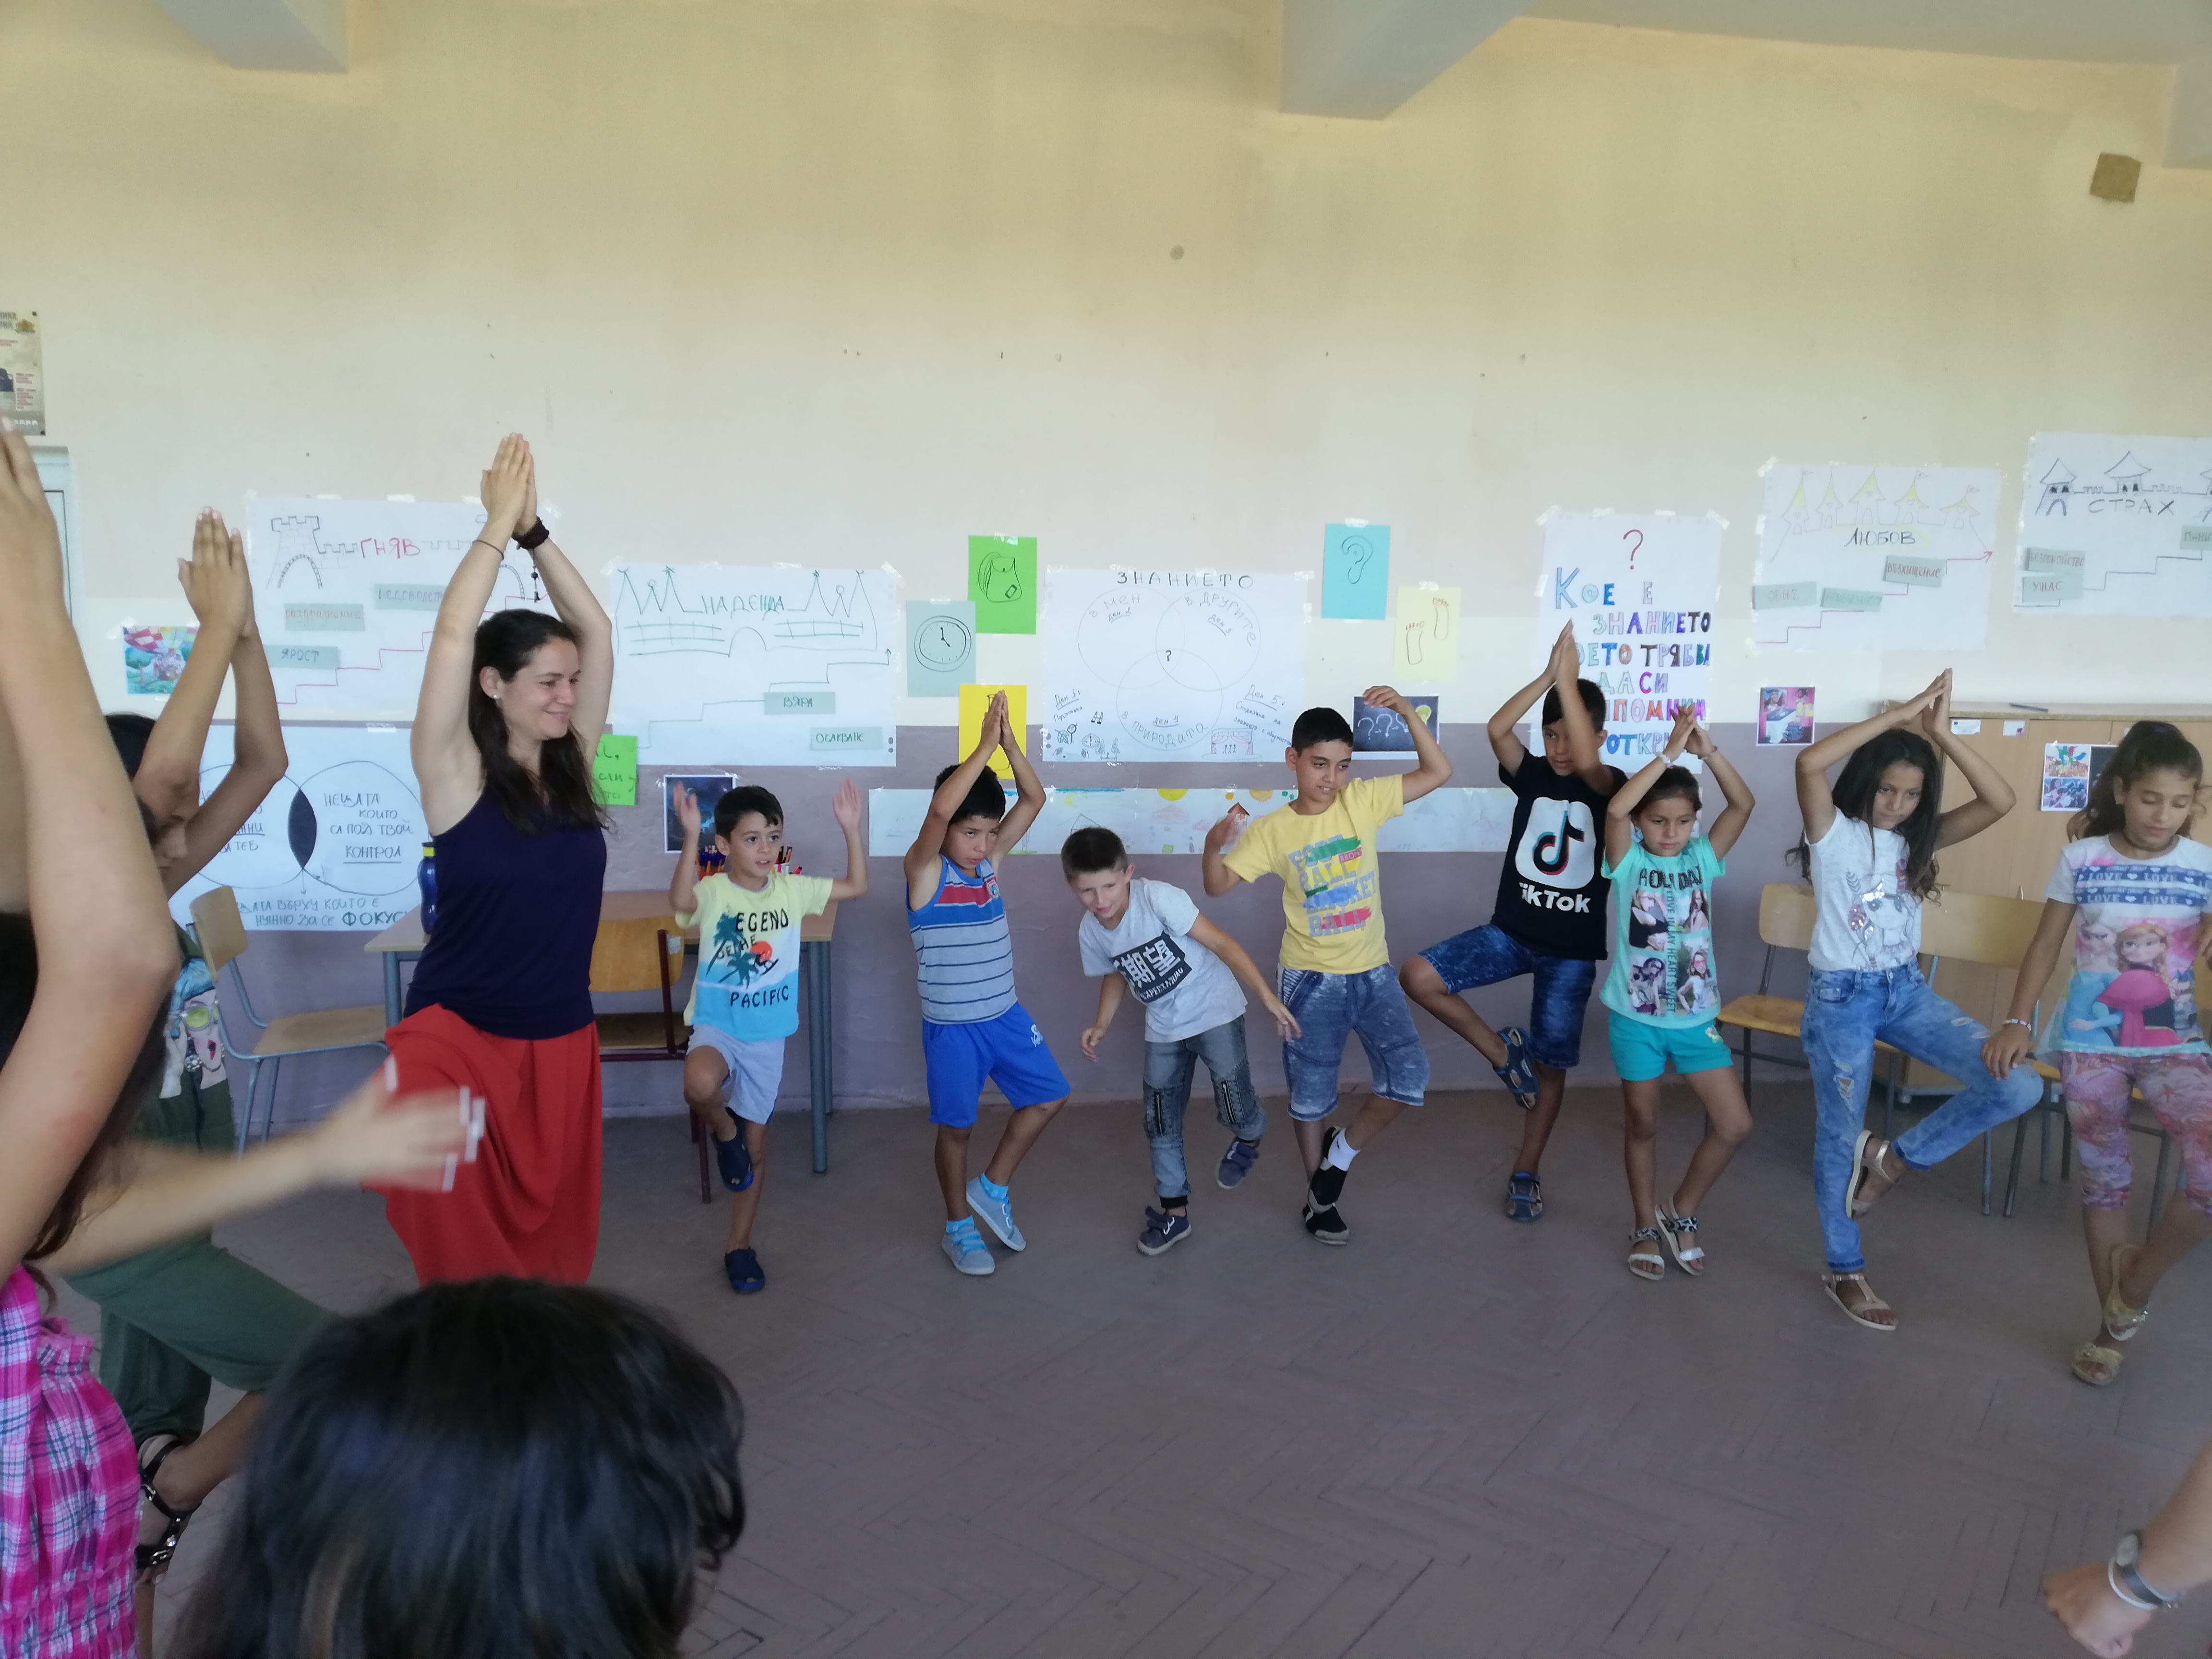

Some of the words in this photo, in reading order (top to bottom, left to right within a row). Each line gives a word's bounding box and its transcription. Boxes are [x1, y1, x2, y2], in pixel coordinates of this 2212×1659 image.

[2087, 499, 2175, 516] СТРАХ
[1844, 527, 1916, 547] ЛЮБОВ
[359, 537, 421, 559] ГНЯВ
[1117, 571, 1254, 589] ЗНАНИЕТО
[2032, 581, 2064, 593] УЖАС
[701, 594, 786, 621] НАДЕЖДА
[1592, 612, 1712, 635] ЗНАНИЕТО
[281, 648, 320, 663] ЯРОСТ
[1575, 642, 1633, 667] ОЕТО
[1640, 643, 1711, 667] ТРЯБВА
[1597, 671, 1635, 695] ДА
[1639, 672, 1669, 695] СИ
[783, 697, 814, 709] ВЯРА
[815, 732, 866, 744] ОЧАКВАНЕ
[325, 793, 380, 808] НЕЩАТА
[359, 809, 398, 819] КОИТО
[330, 824, 343, 834] СА
[347, 823, 373, 835] ПОД
[379, 817, 414, 835] ТВОЙ
[345, 845, 402, 859] КОНТРОЛ
[2088, 872, 2123, 882] LOVE
[325, 898, 367, 910] КОИТО
[2087, 894, 2121, 903] LOVE
[255, 914, 294, 927] НУЖНО
[342, 911, 409, 926] ФОКУС
[735, 907, 789, 932] EGEND
[1667, 948, 1676, 978] HEART
[730, 984, 789, 1009] PACIFIC
[1667, 981, 1677, 1013] SWEET
